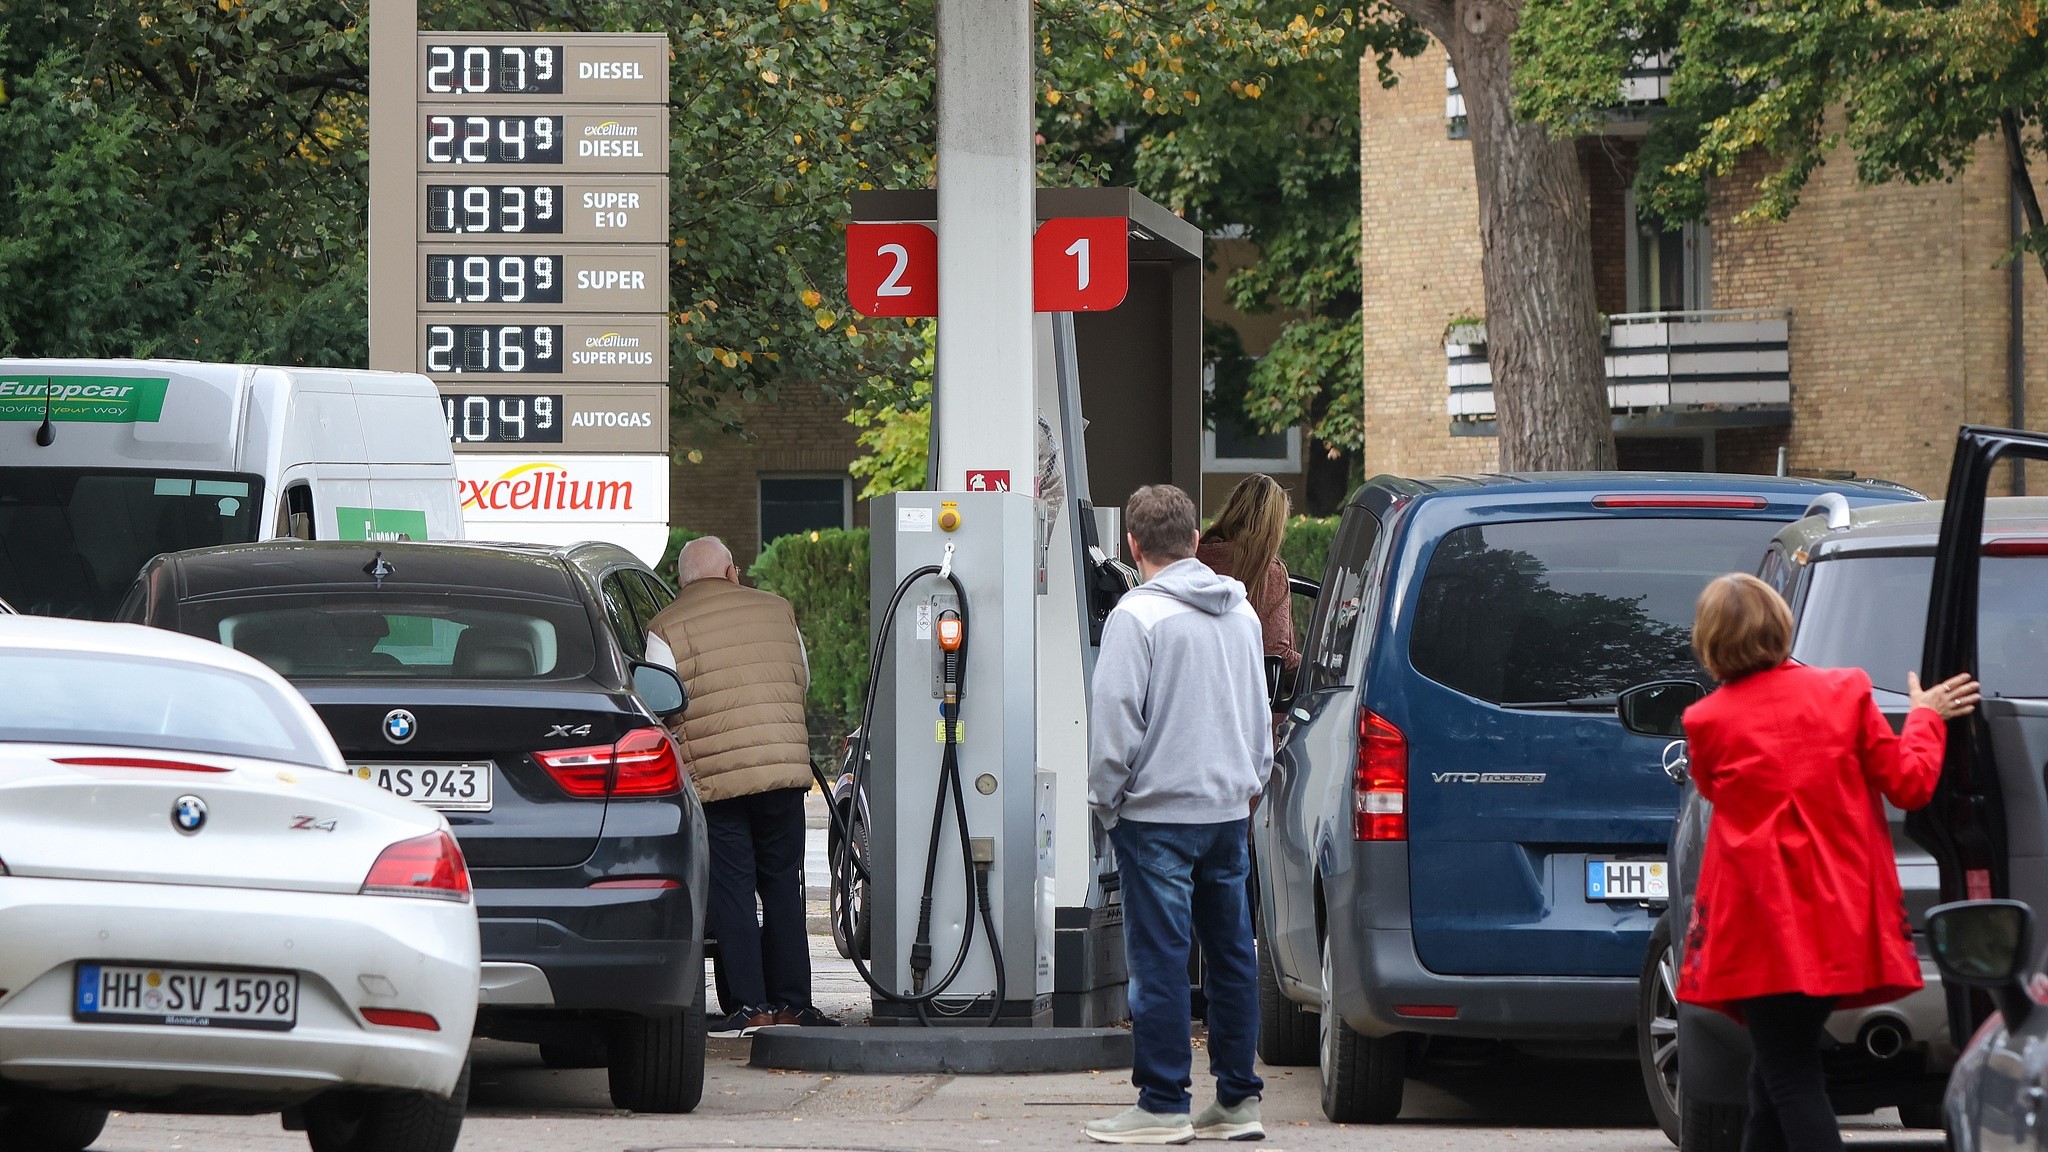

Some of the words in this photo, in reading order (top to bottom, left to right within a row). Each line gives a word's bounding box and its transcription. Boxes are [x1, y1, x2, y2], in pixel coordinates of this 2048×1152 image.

[578, 62, 644, 80] DIESEL
[584, 121, 638, 137] excellium
[578, 140, 644, 157] DIESEL
[583, 192, 640, 209] SUPER
[595, 211, 628, 228] E10
[876, 243, 912, 297] 2
[1064, 238, 1090, 291] 1
[577, 270, 645, 290] SUPER
[585, 334, 640, 348] excellium
[572, 351, 616, 365] SUPER
[618, 351, 653, 365] PLUS
[0, 381, 134, 401] Europcar
[51, 405, 91, 416] your
[93, 407, 128, 416] way
[571, 411, 652, 428] AUTOGAS
[544, 724, 592, 737] X4
[421, 769, 475, 798] 943
[1431, 772, 1480, 783] VITO
[1485, 774, 1542, 783] TOURER
[289, 814, 338, 832] Z4
[1593, 882, 1600, 892] D
[1606, 865, 1645, 893] HH
[102, 972, 143, 1008] HH
[167, 975, 207, 1011] SV
[214, 977, 290, 1015] 1598
